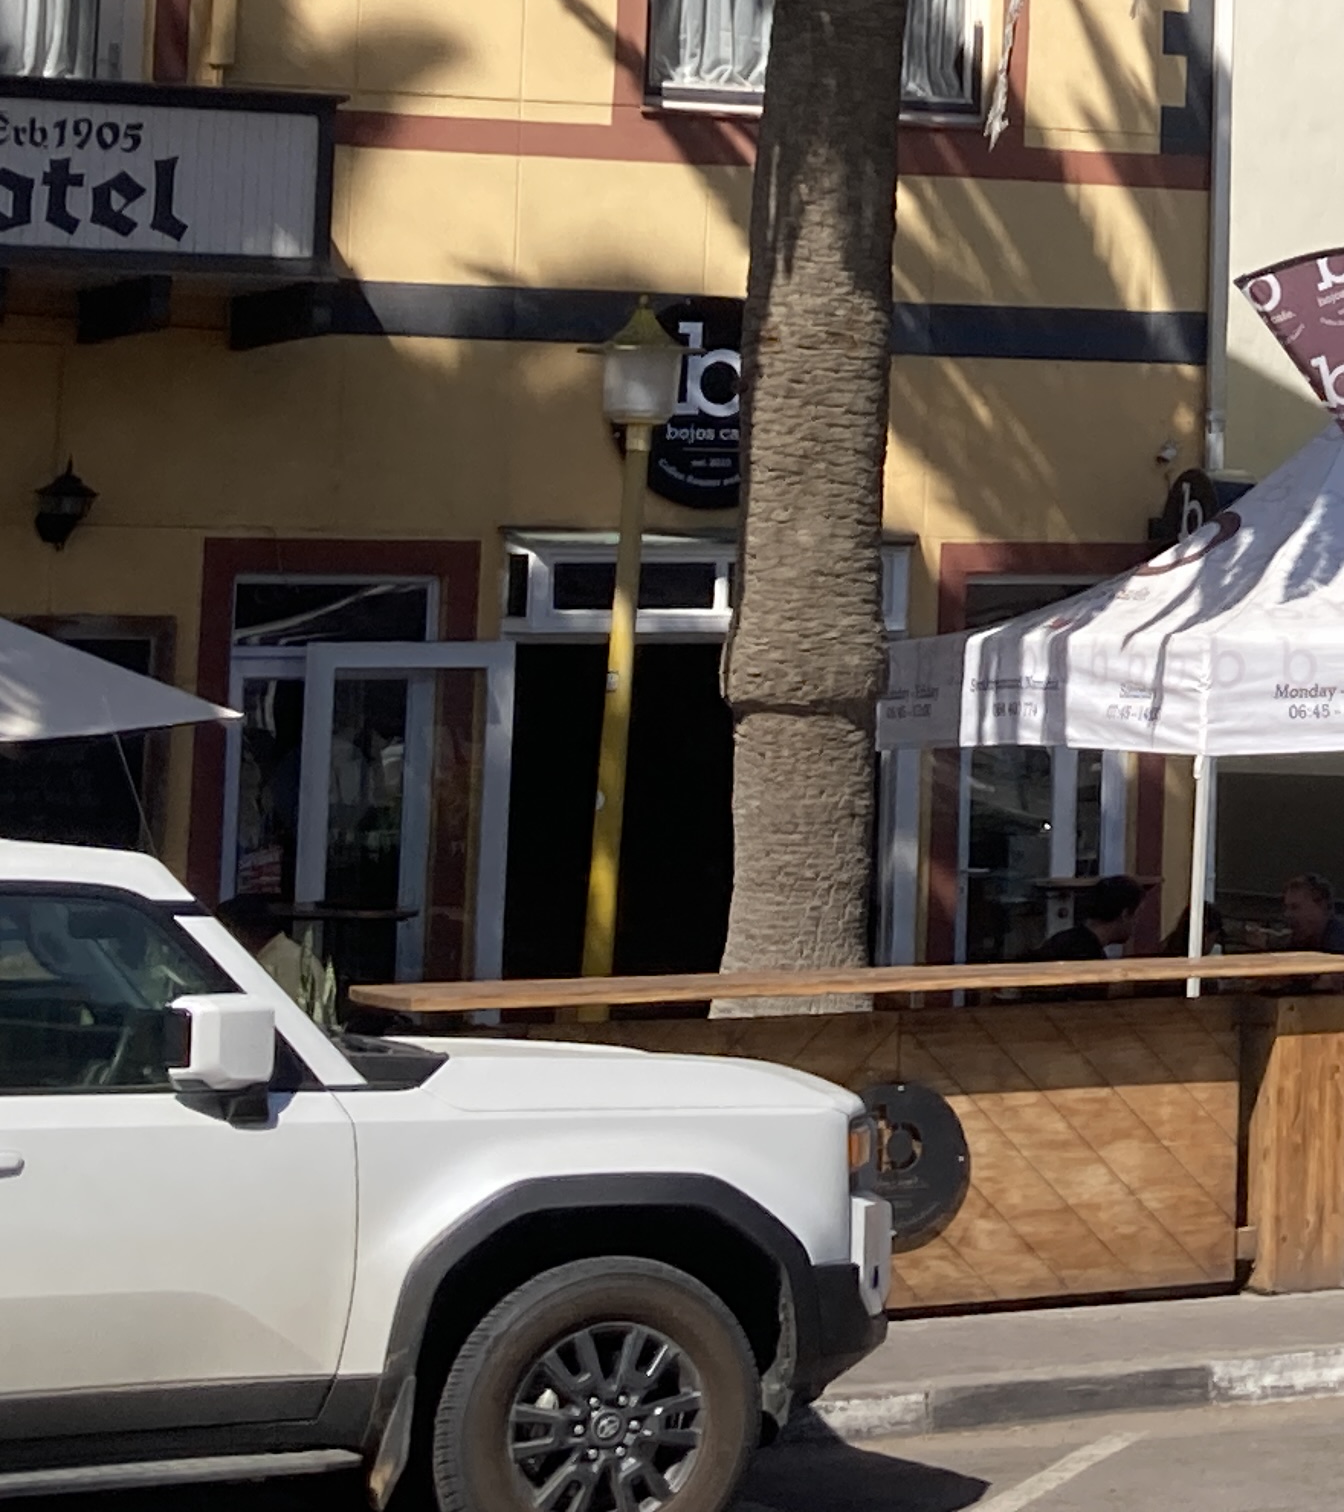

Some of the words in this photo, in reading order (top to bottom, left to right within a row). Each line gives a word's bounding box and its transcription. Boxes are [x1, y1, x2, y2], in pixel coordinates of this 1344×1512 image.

[53, 117, 144, 153] 1905
[672, 321, 742, 418] b
[1273, 683, 1337, 702] Monday
